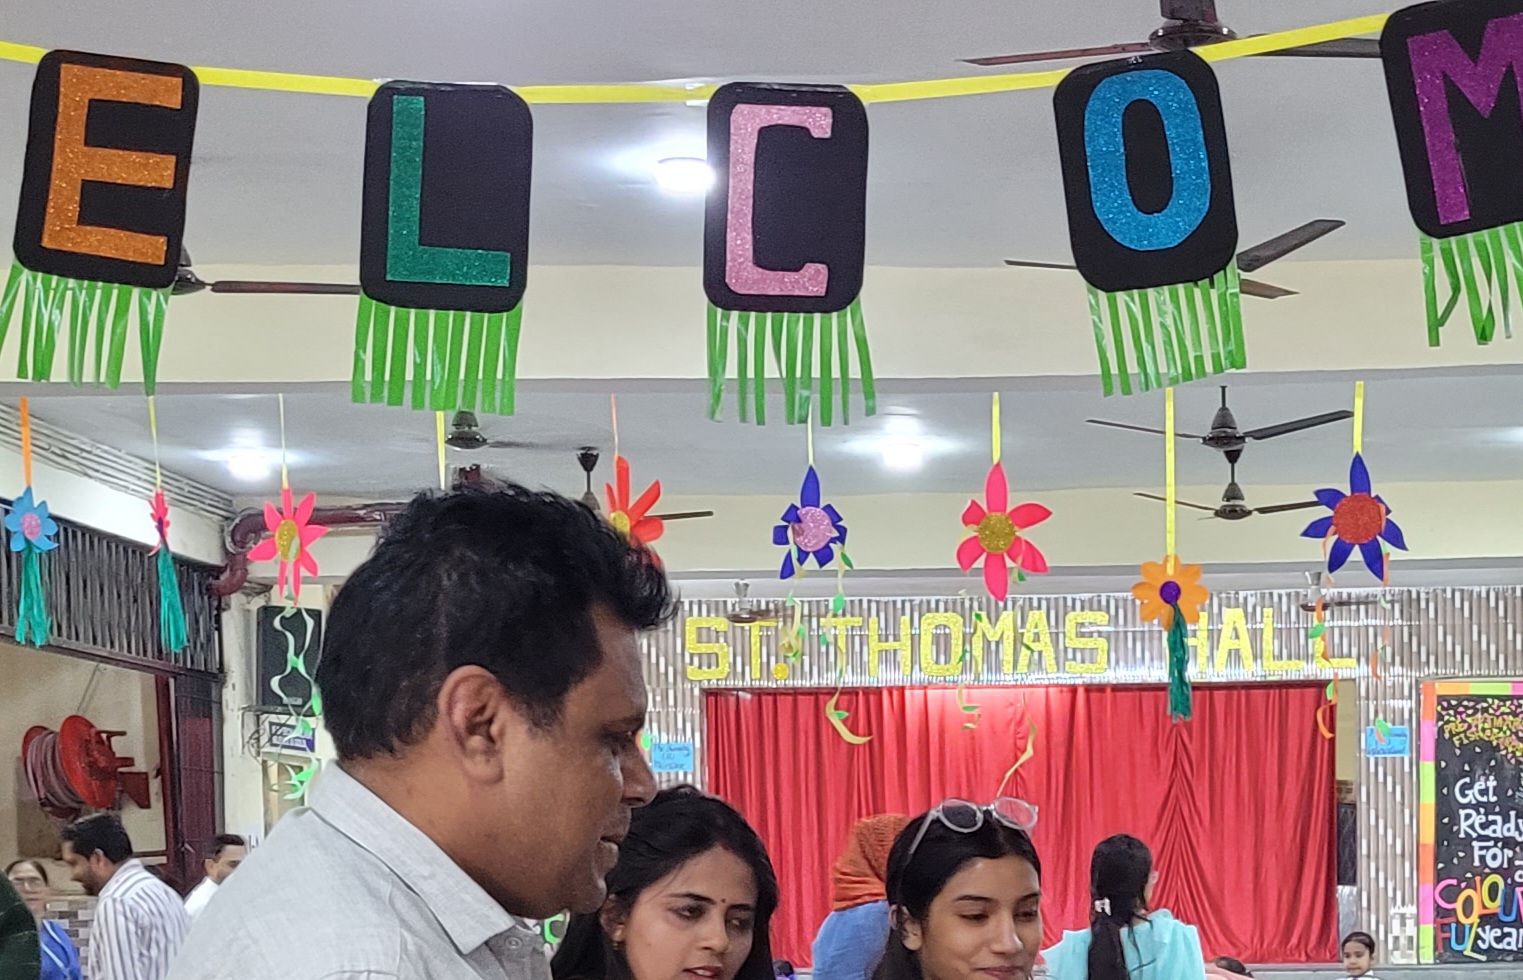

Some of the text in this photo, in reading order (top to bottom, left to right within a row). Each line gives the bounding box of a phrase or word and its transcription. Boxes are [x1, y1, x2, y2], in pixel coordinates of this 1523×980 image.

[819, 609, 1109, 678] THOMAS
[1454, 775, 1498, 805] Get
[1471, 840, 1514, 869] For
